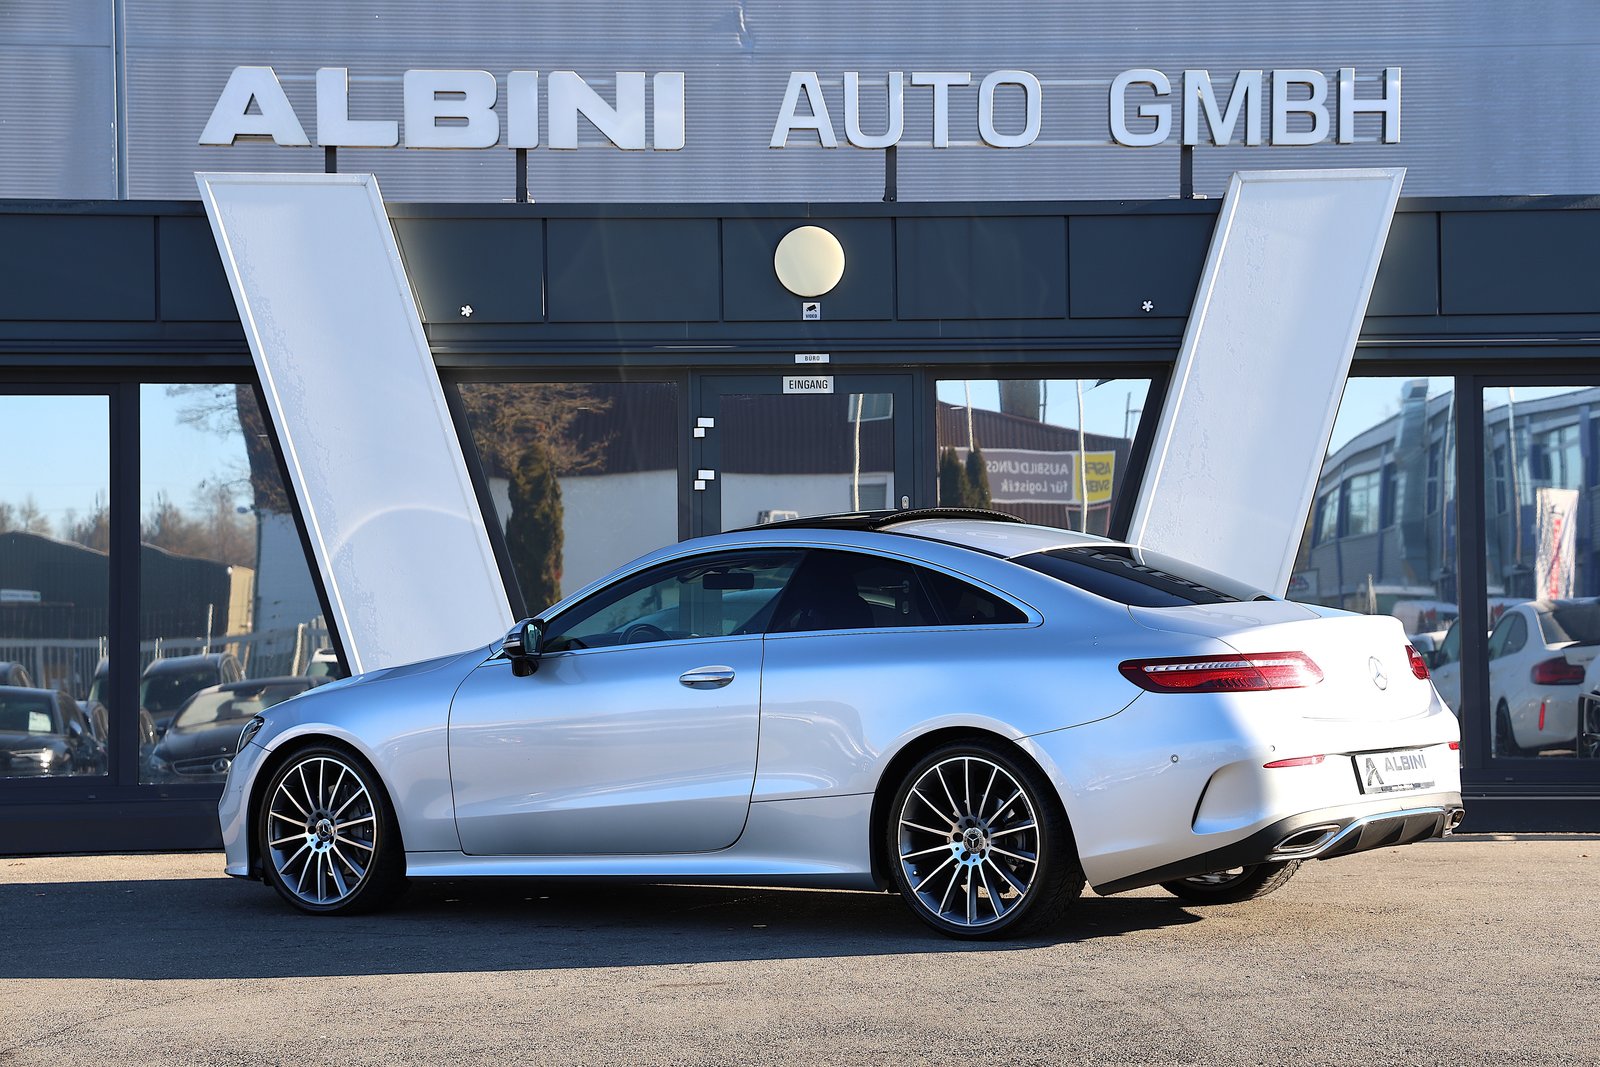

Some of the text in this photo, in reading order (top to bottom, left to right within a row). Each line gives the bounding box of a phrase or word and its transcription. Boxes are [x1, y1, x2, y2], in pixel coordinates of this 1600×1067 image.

[198, 66, 1402, 150] ALBINI AUTO GMBH
[789, 380, 828, 390] EINGANG
[1385, 754, 1427, 772] ALBINI
